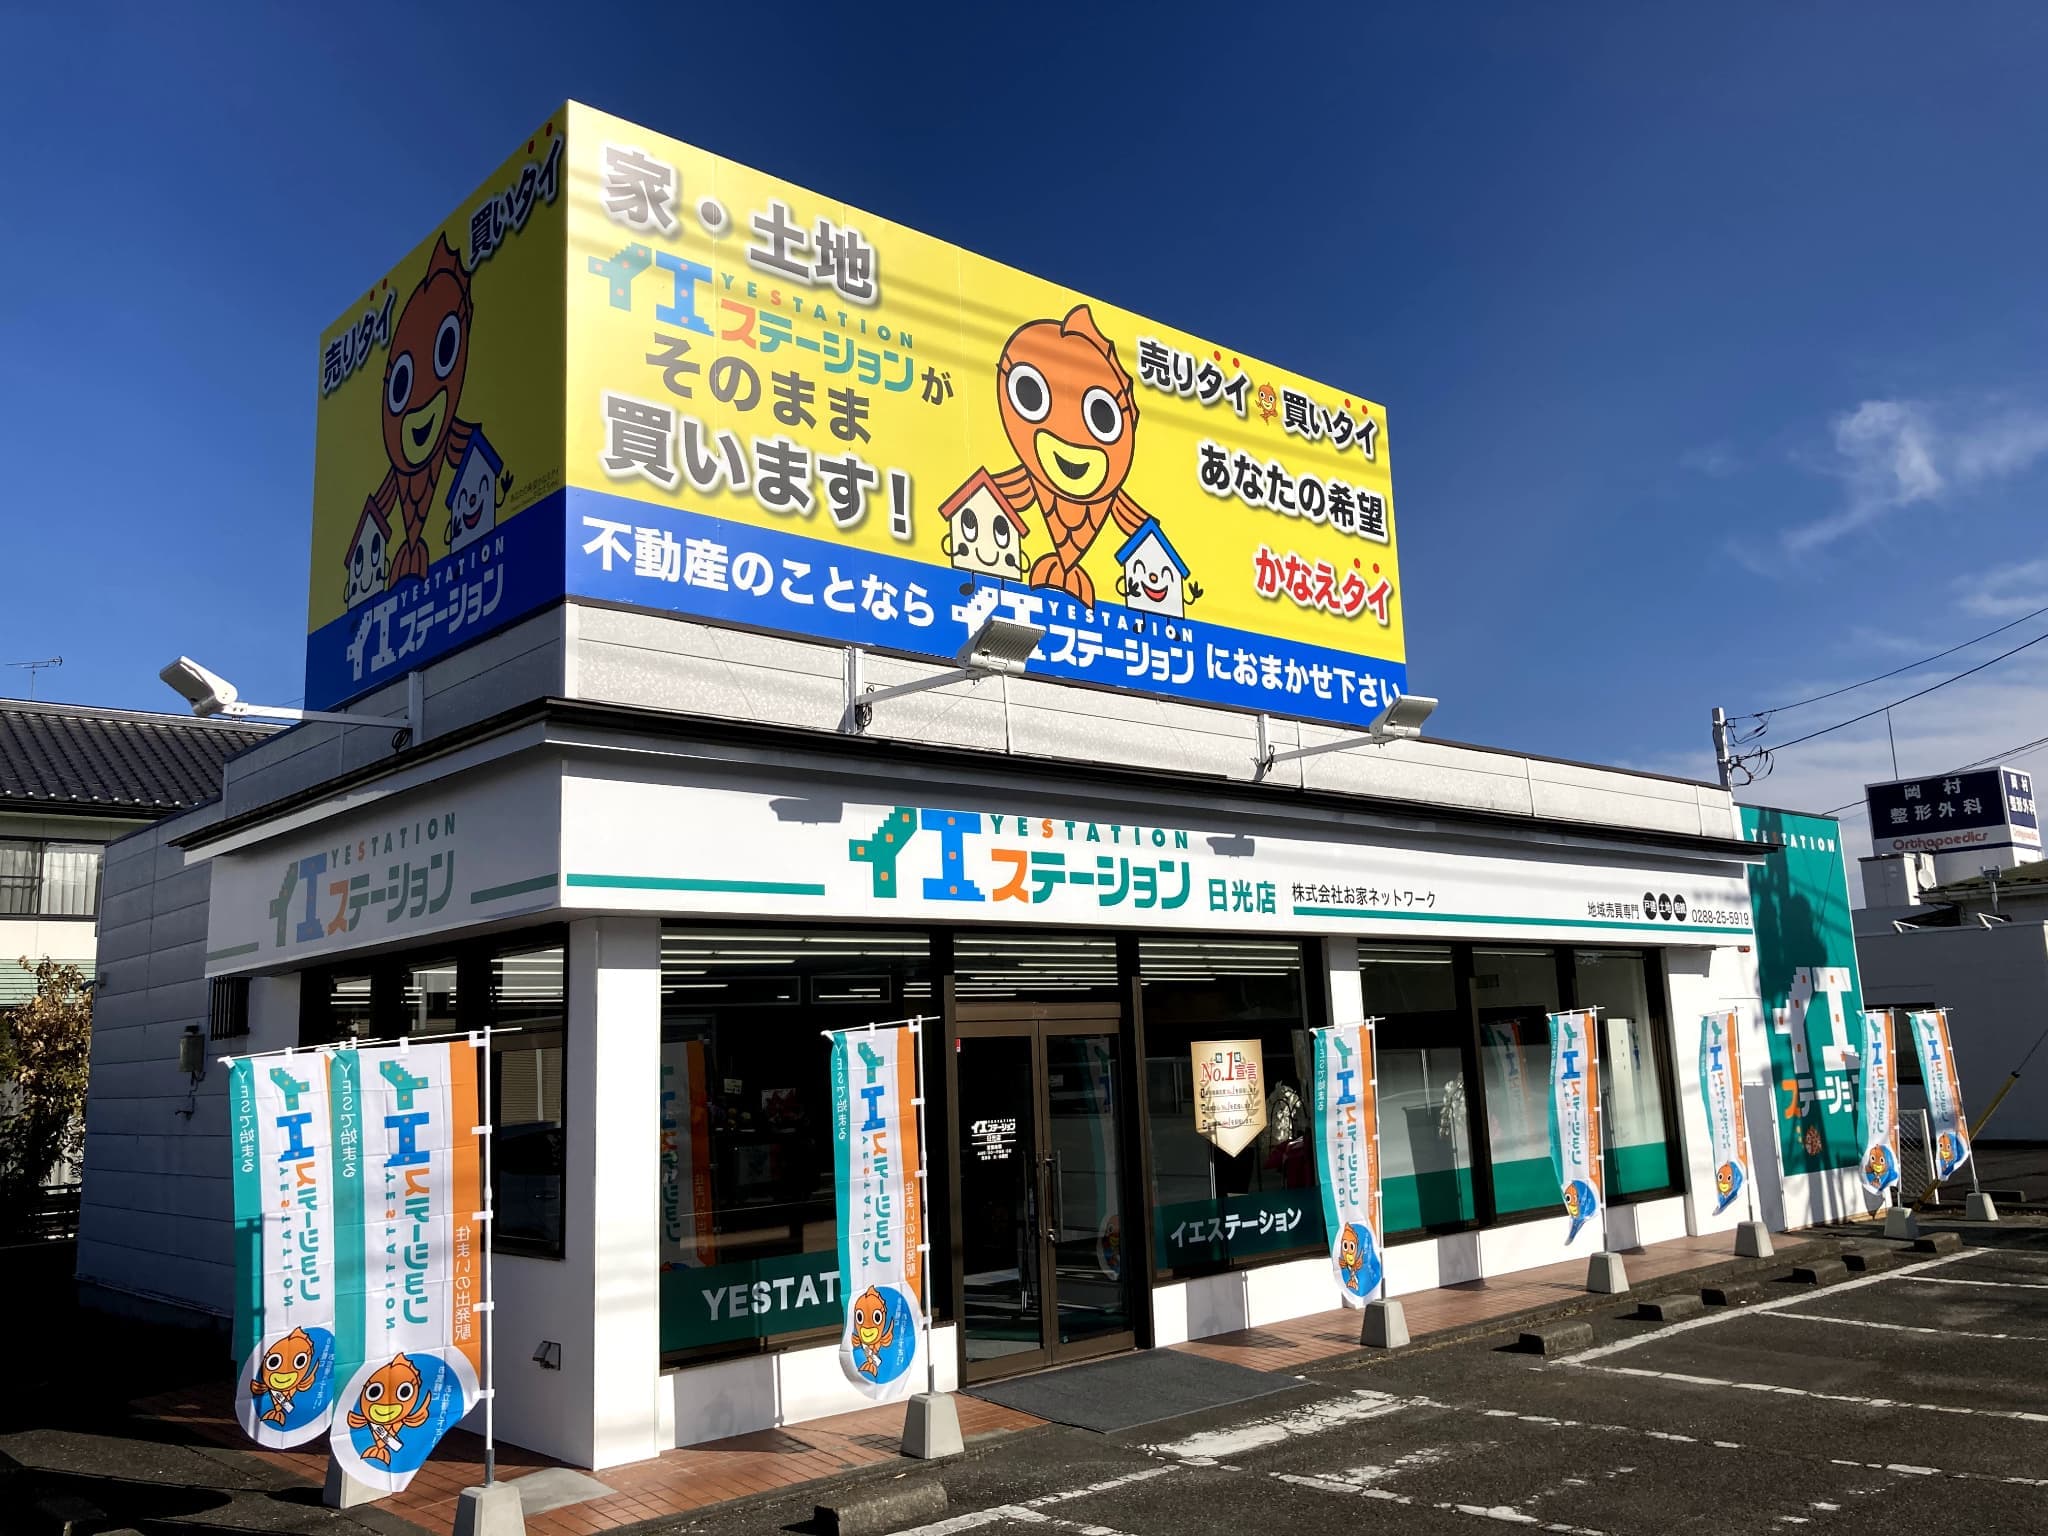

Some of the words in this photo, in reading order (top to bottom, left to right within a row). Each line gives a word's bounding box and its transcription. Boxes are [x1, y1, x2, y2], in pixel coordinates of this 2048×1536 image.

[471, 140, 560, 262] 買いタイ
[607, 147, 873, 300] 家・土地
[324, 295, 395, 392] 売りタイ
[720, 272, 914, 348] YESTATION
[645, 333, 871, 443] そのまま
[1140, 339, 1249, 413] 売りタイ
[1283, 389, 1377, 455] 買いタイ
[1201, 445, 1386, 537] あなたの希望
[401, 535, 504, 606] YESTATION
[1256, 549, 1390, 621] かなえタイ
[346, 562, 504, 680] イエステーション
[583, 515, 935, 628] 不動産のことなら
[1206, 642, 1400, 708] におまかせ下さい
[1048, 599, 1194, 644] YESTATION
[1890, 797, 1983, 825] 整形外科
[1904, 778, 1962, 800] 岡村
[331, 812, 456, 869] YESTATION
[849, 805, 1190, 909] イエステーション
[1209, 878, 1276, 914] 日光店
[1291, 883, 1436, 909] 株式会社お家ネットワーク
[991, 814, 1189, 850] YESTATION
[1892, 831, 1988, 851] Orthopaedics
[268, 851, 455, 948] イエステーション
[1691, 908, 1749, 926] 0288-25-5919
[1170, 1208, 1302, 1248] イエステーション
[702, 1271, 840, 1321] YESTAT
